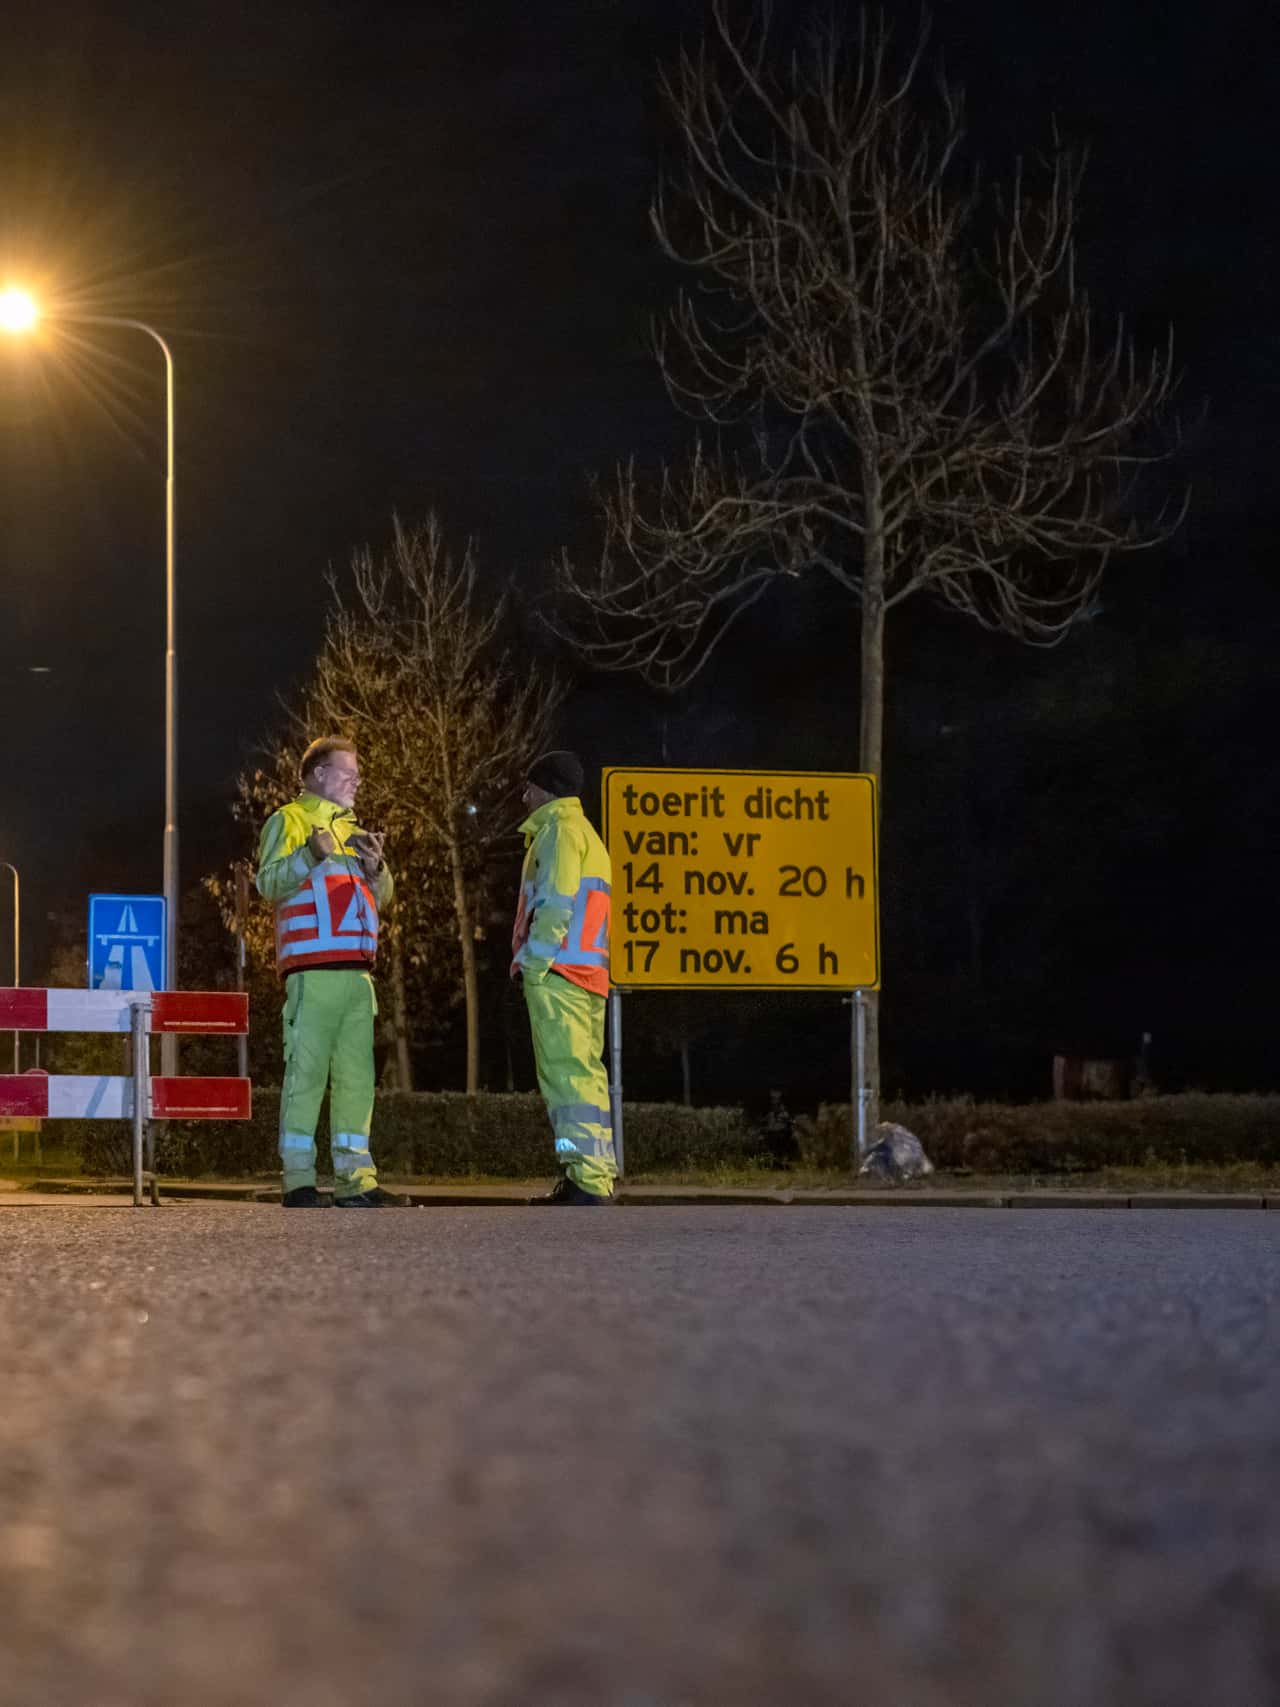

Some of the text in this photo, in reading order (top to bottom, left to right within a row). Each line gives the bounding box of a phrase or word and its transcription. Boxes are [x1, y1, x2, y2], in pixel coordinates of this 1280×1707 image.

[623, 784, 829, 821] toerit dicht
[624, 831, 760, 856] van: vr
[623, 862, 864, 898] 14 nov. 20 h
[623, 902, 768, 934] tot: ma
[624, 940, 838, 975] 17 nov. 6 h
